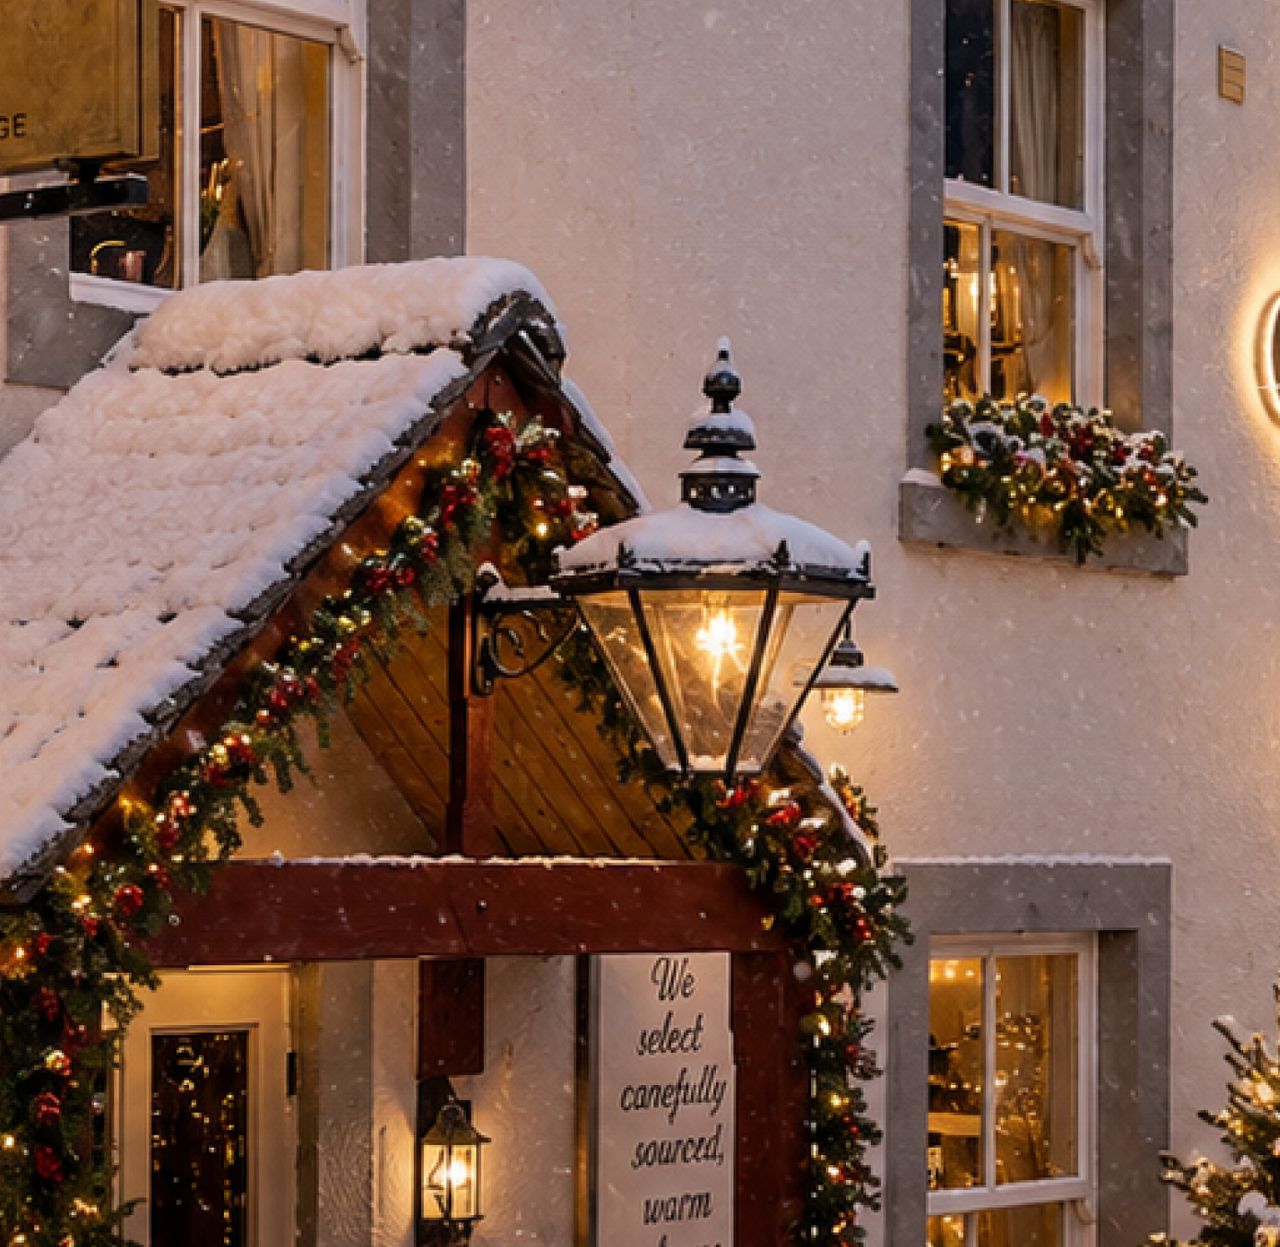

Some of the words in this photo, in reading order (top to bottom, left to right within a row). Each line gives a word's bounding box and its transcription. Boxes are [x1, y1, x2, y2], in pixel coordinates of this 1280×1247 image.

[650, 956, 696, 1002] We
[634, 1009, 704, 1057] select
[620, 1064, 727, 1126] carefully
[630, 1122, 725, 1170] sourced,
[642, 1192, 712, 1226] warm
